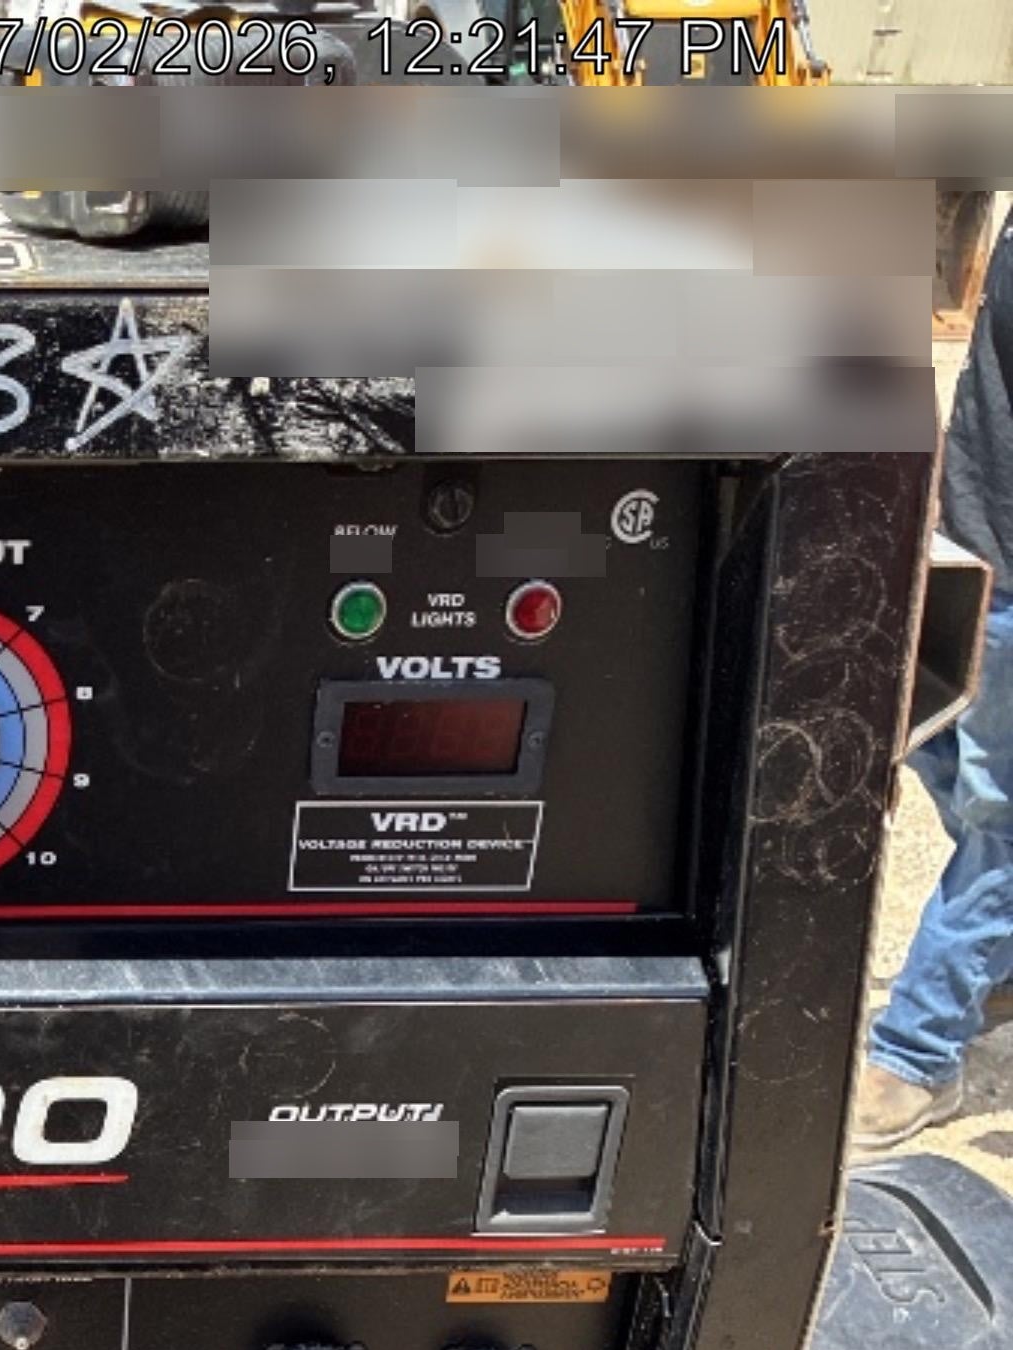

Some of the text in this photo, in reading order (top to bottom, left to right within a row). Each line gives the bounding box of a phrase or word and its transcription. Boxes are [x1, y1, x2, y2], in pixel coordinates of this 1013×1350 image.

[428, 593, 466, 608] VRD
[26, 605, 45, 623] 7
[411, 612, 477, 628] LIGHTS
[377, 656, 502, 680] VOLTS
[77, 686, 93, 700] 8
[73, 774, 90, 788] 9
[298, 839, 366, 850] VOLTAGE
[371, 839, 462, 850] REDUCTION
[25, 851, 57, 866] 10
